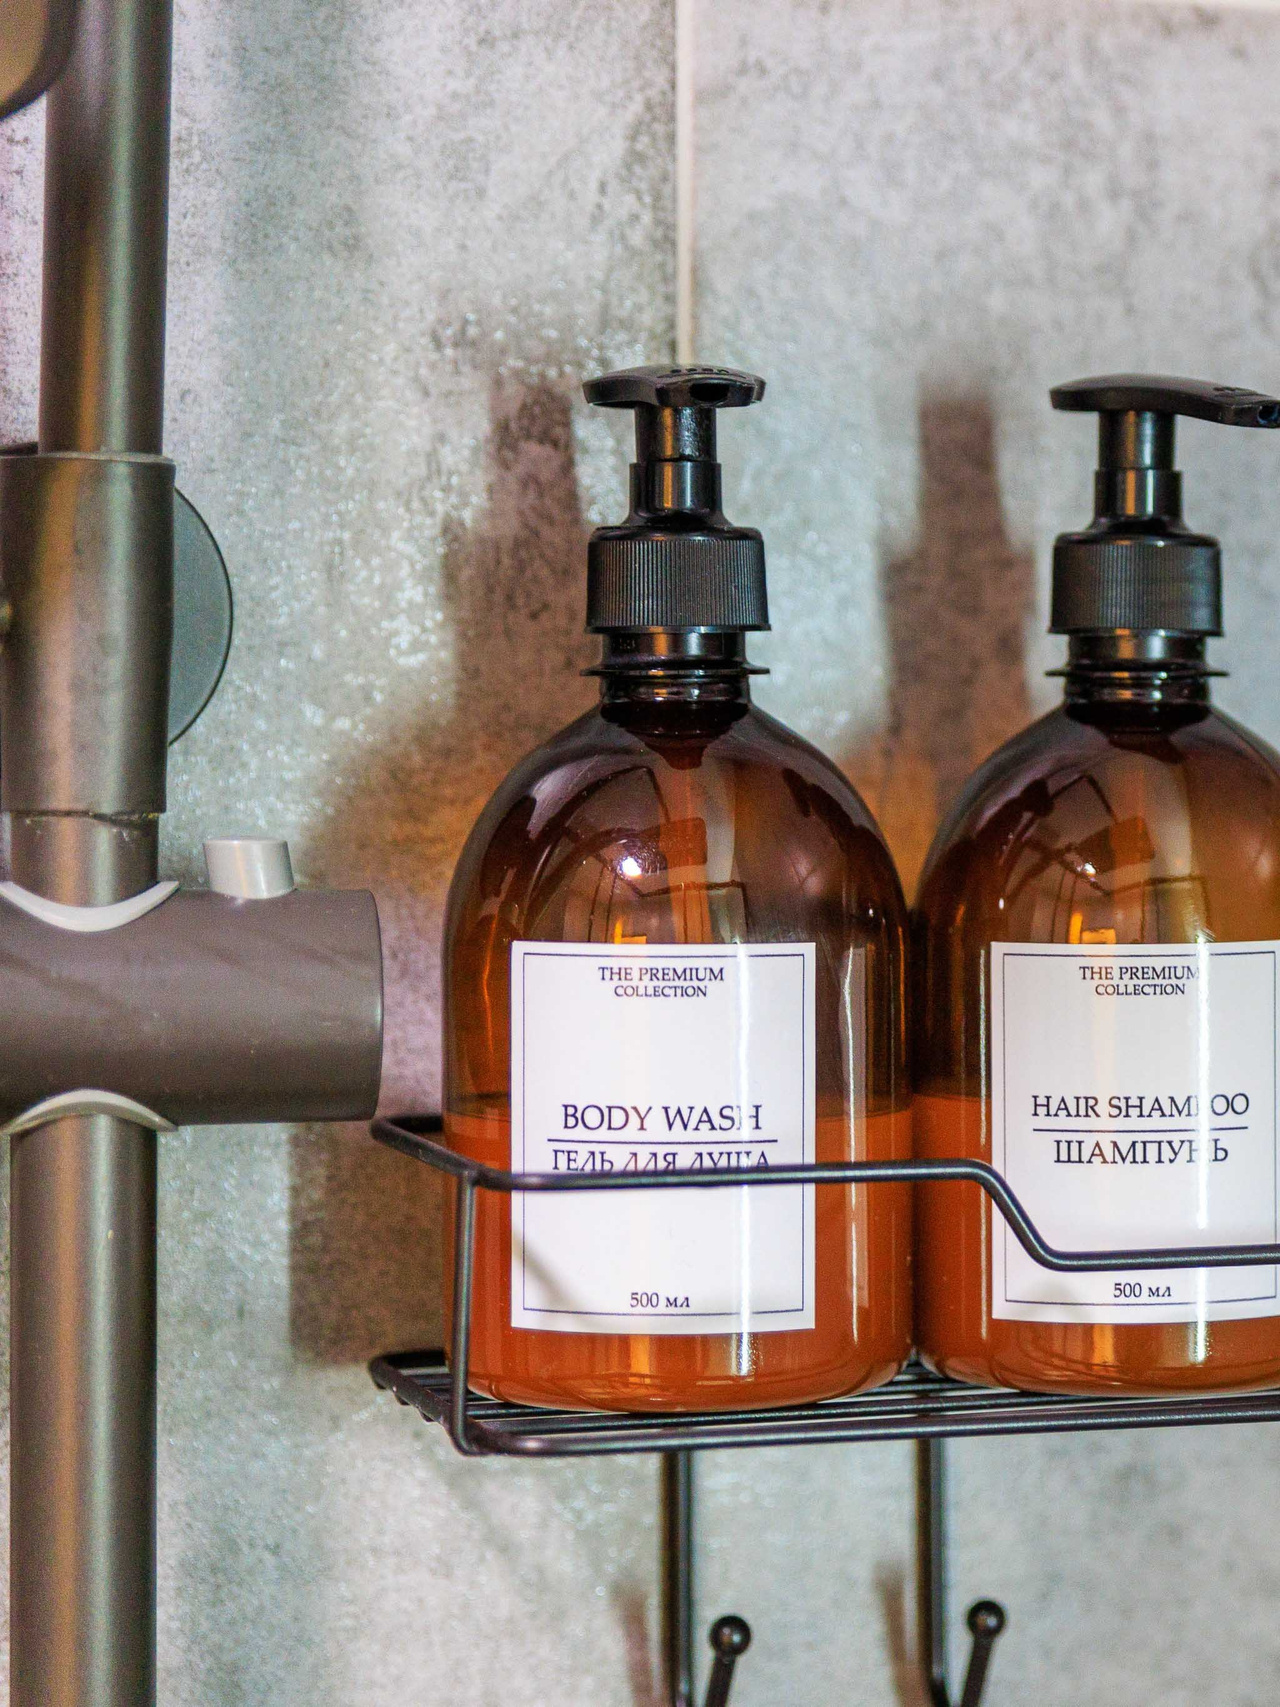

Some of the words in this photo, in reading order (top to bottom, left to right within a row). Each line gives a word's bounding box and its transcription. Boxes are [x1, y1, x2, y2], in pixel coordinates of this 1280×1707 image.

[598, 966, 633, 981] THE
[639, 966, 725, 981] PREMIUM
[1079, 966, 1114, 980] THE
[614, 985, 708, 998] COLLECTION
[1095, 983, 1186, 996] COLLECTION
[1031, 1095, 1101, 1118] HAIR
[562, 1104, 652, 1131] BODY
[552, 1149, 614, 1173] ГЕЛЬ
[1113, 1282, 1142, 1298] 500
[1148, 1286, 1172, 1298] мл
[630, 1292, 659, 1308] 500
[665, 1296, 690, 1308] мл
